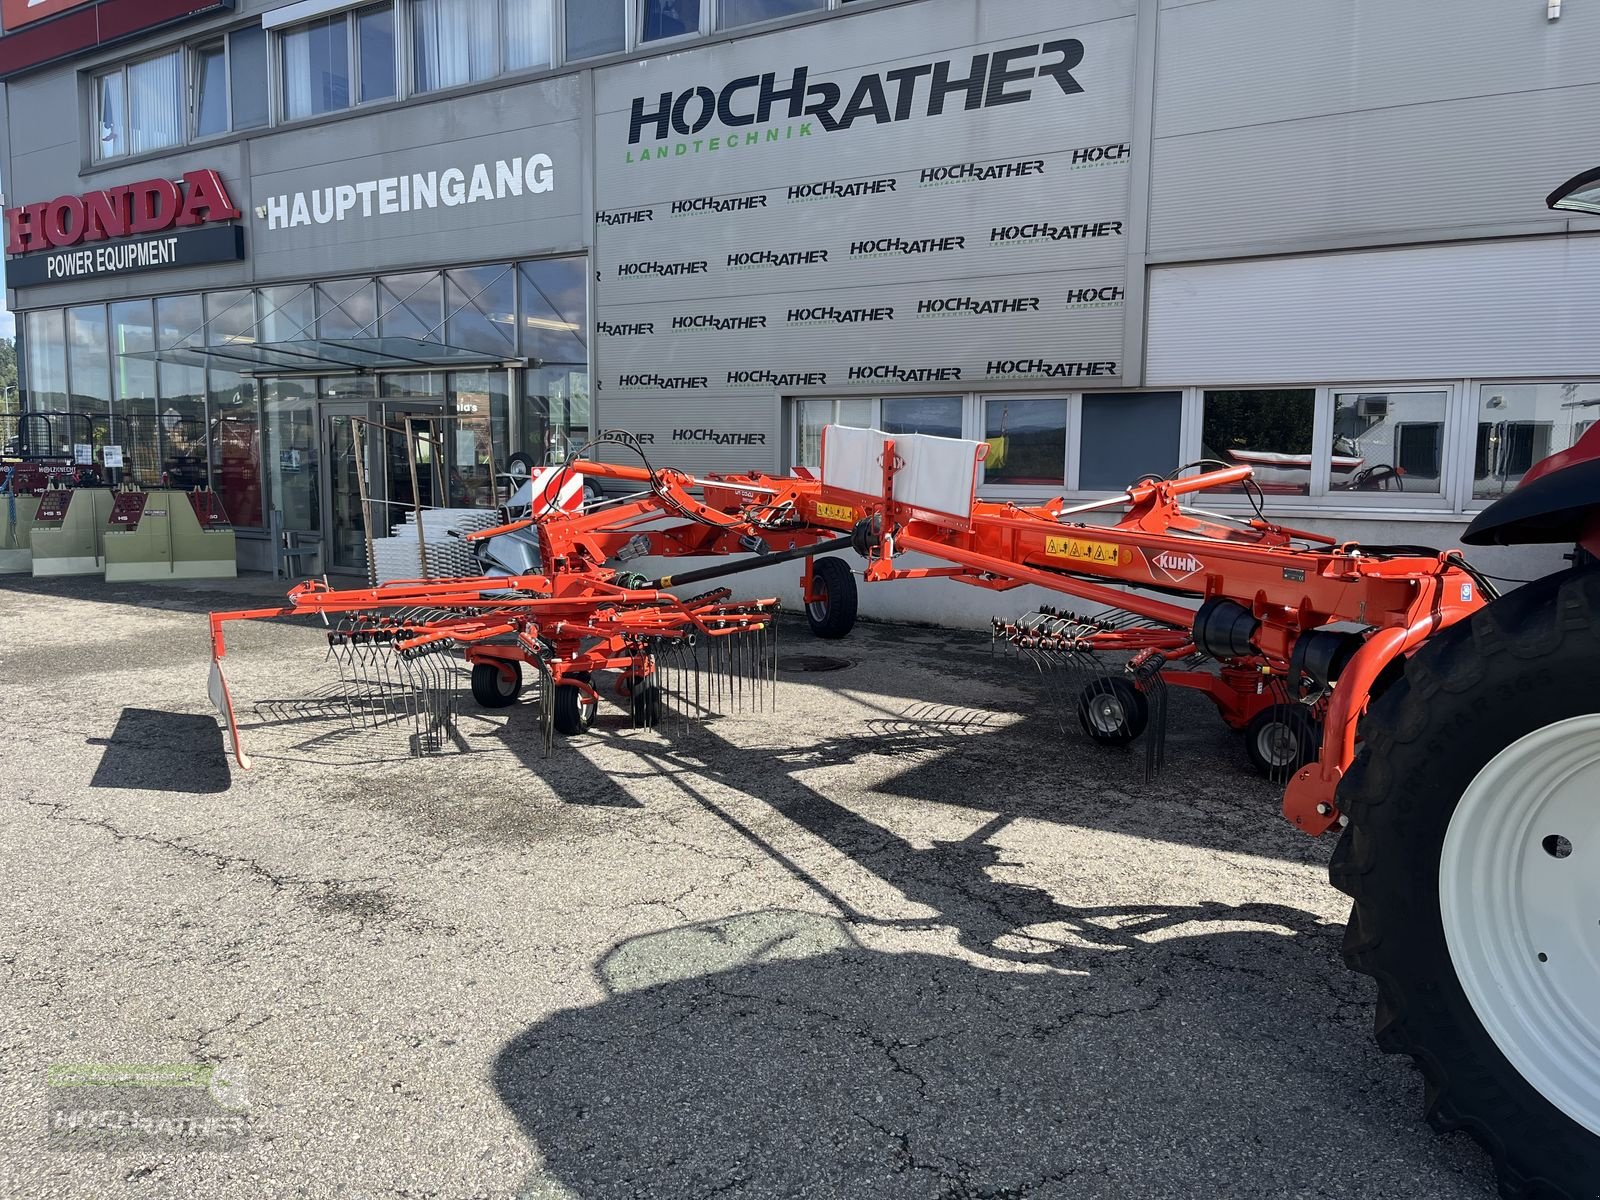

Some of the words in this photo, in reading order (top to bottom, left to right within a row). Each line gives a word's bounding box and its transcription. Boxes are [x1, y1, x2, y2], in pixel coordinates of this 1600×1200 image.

[628, 38, 1085, 144] HOCHRATHER
[626, 122, 812, 163] LANDTECHNIK
[1071, 143, 1130, 164] HOCH
[920, 160, 1044, 182] HOCHRATHER
[267, 153, 554, 230] HAUPTEINGANG
[787, 179, 897, 199] HOCHRATHER
[6, 169, 240, 254] HONDA
[671, 195, 767, 213] HOCHRATHER
[990, 221, 1122, 241] HOCHRATHER
[850, 236, 965, 254] HOCHRATHER
[48, 250, 94, 278] POWER
[97, 237, 178, 272] EQUIPMENT
[727, 250, 828, 266] HOCHRATHER
[618, 261, 707, 276] HOCHRATHER
[1067, 286, 1124, 303] HOCH
[917, 297, 1040, 314] HOCHRATHER
[672, 315, 767, 330] HOCHRATHER
[787, 307, 894, 322] HOCHRATHER
[848, 365, 961, 381] HOCHRATHER
[986, 359, 1116, 376] HOCHRATHER
[619, 374, 708, 389] HOCHRATHER
[727, 370, 827, 385] HOCHRATHER
[672, 429, 766, 445] HOCHRATHER
[1160, 555, 1196, 572] KUHN
